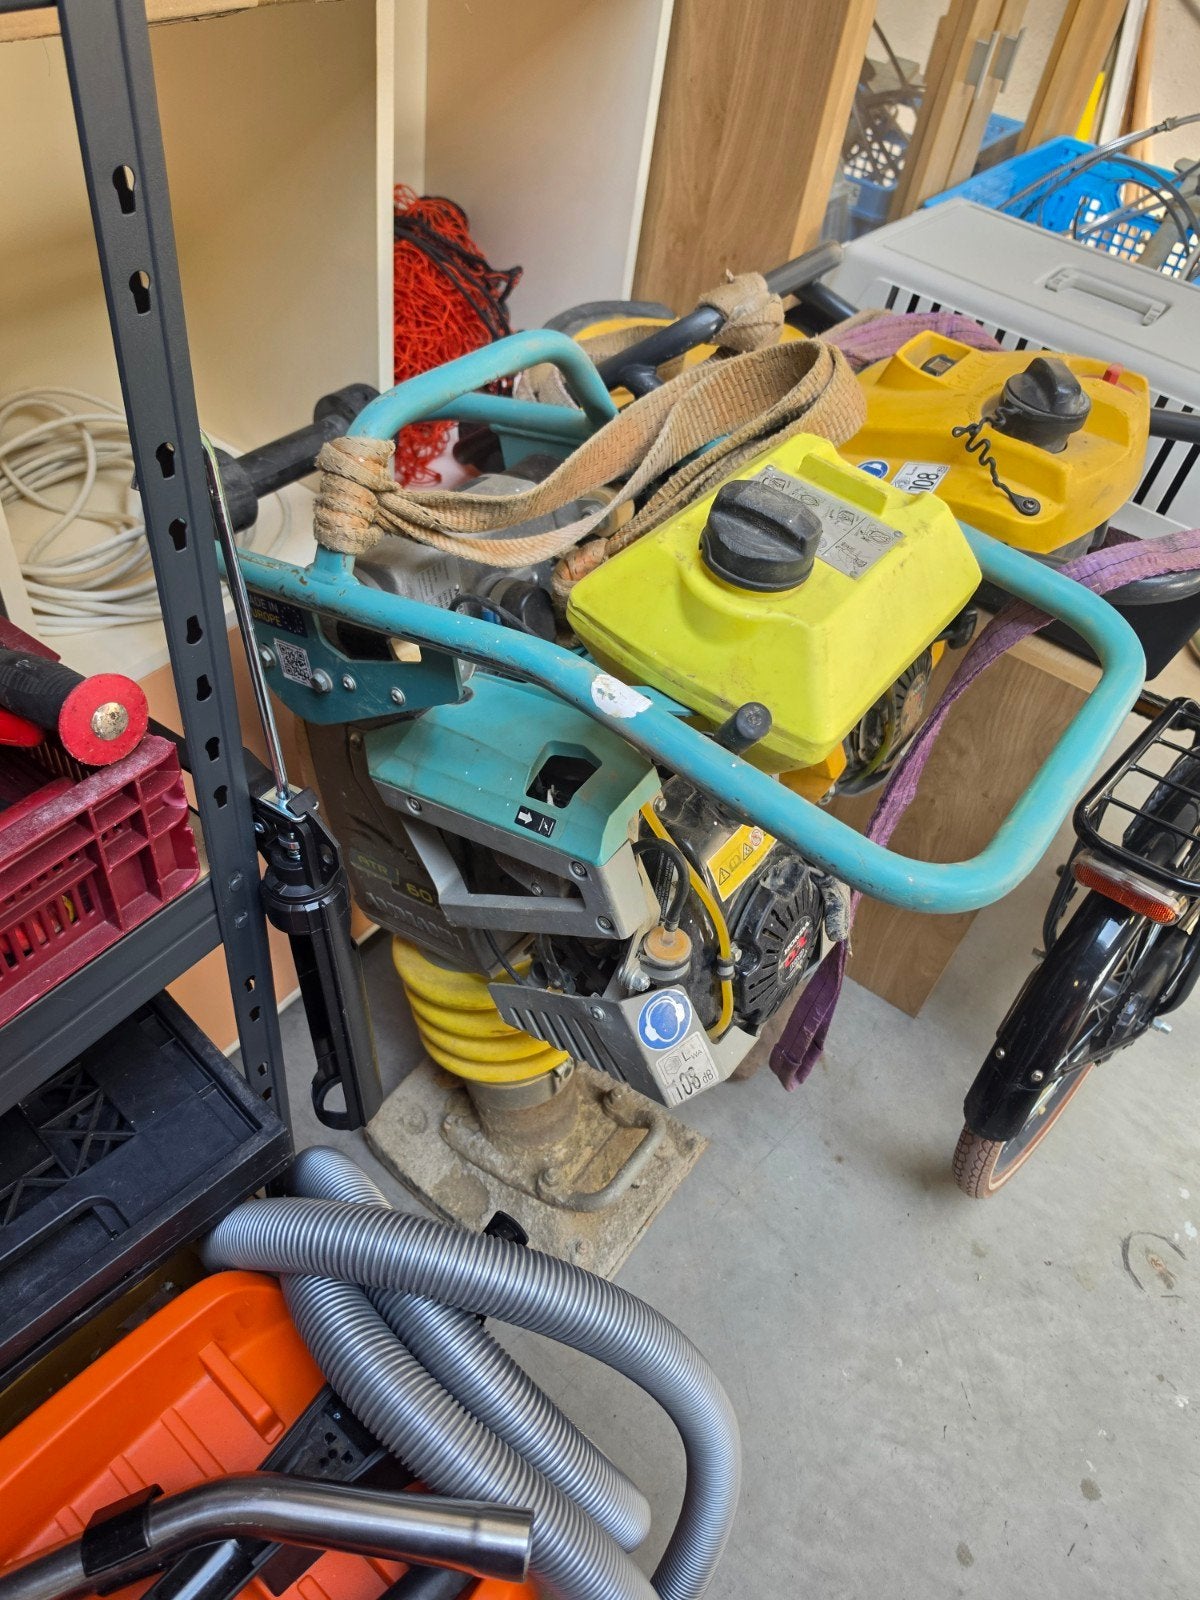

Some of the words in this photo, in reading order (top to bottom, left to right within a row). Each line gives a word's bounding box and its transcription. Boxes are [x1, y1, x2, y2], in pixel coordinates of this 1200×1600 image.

[908, 473, 939, 491] 108
[253, 608, 283, 626] UROPE
[405, 883, 433, 903] 60
[671, 1066, 702, 1102] 108
[702, 1069, 715, 1084] dB
